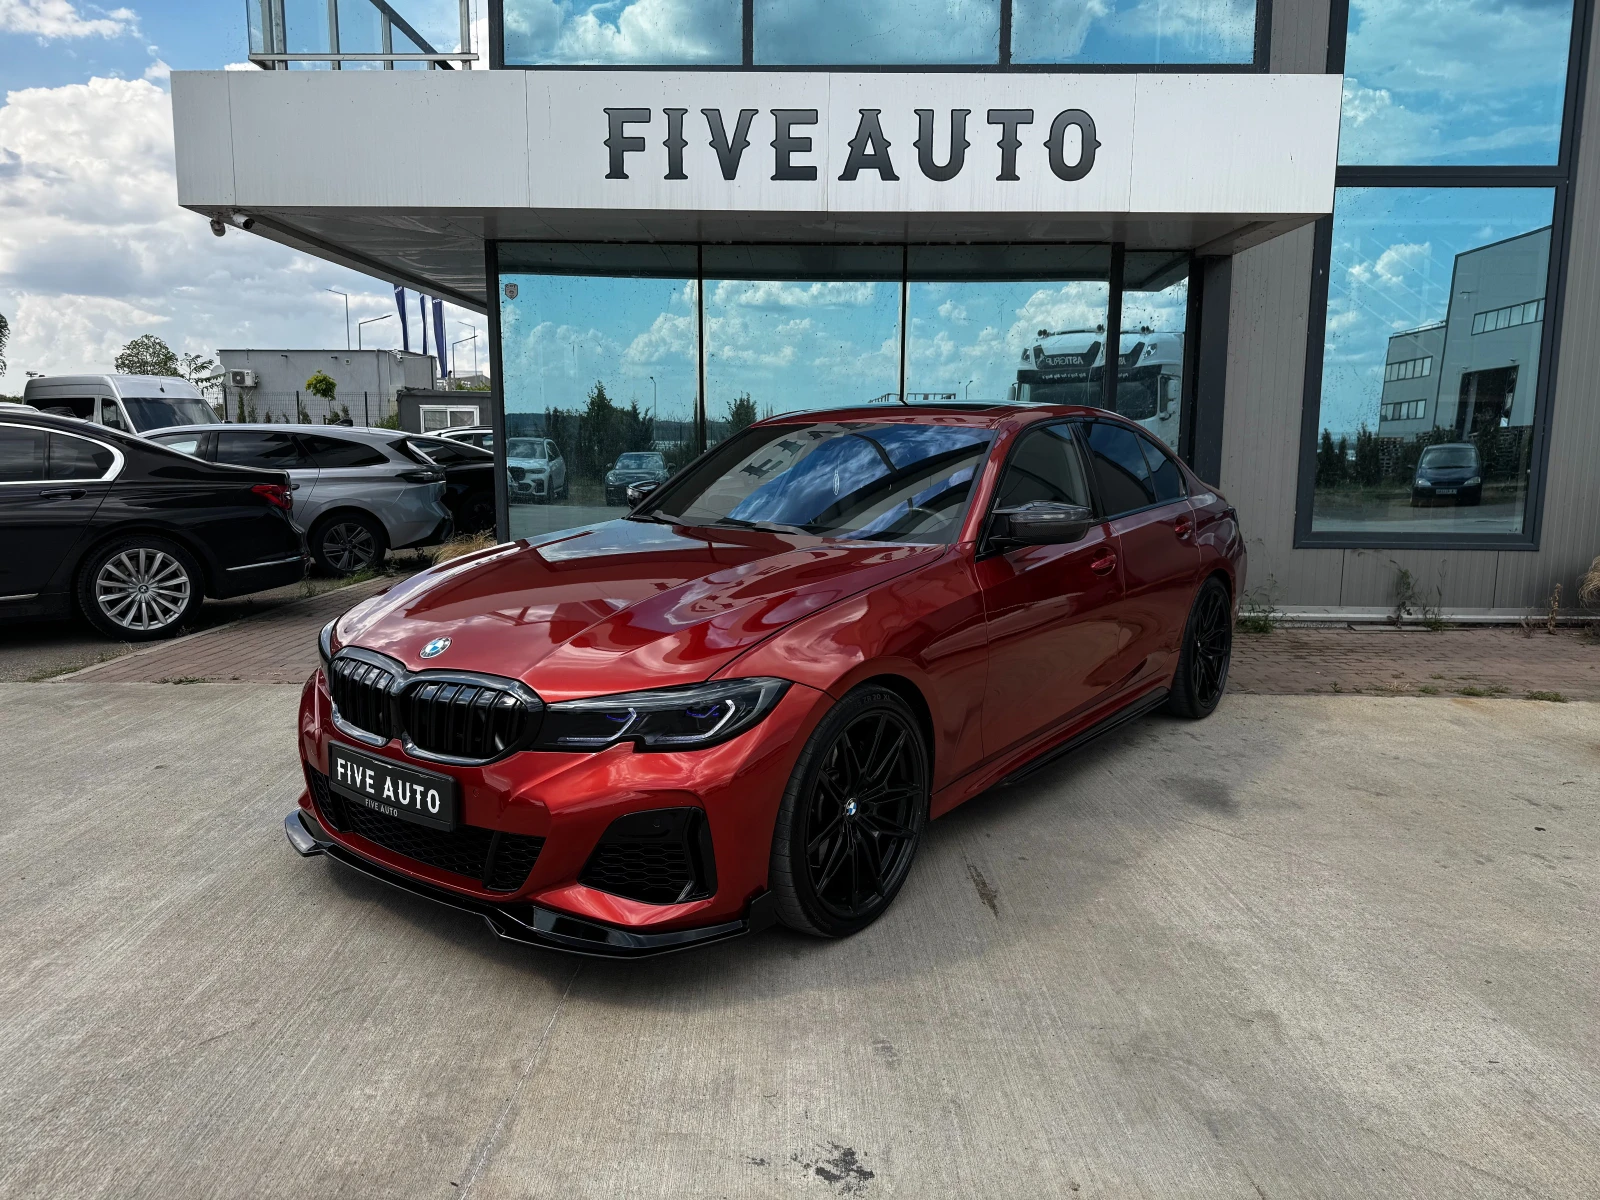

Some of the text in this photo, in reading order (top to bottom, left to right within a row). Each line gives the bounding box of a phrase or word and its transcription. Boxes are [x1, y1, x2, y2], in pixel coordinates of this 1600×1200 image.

[336, 757, 441, 814] FIVE AUTO
[365, 798, 398, 817] FIVE AUTO
